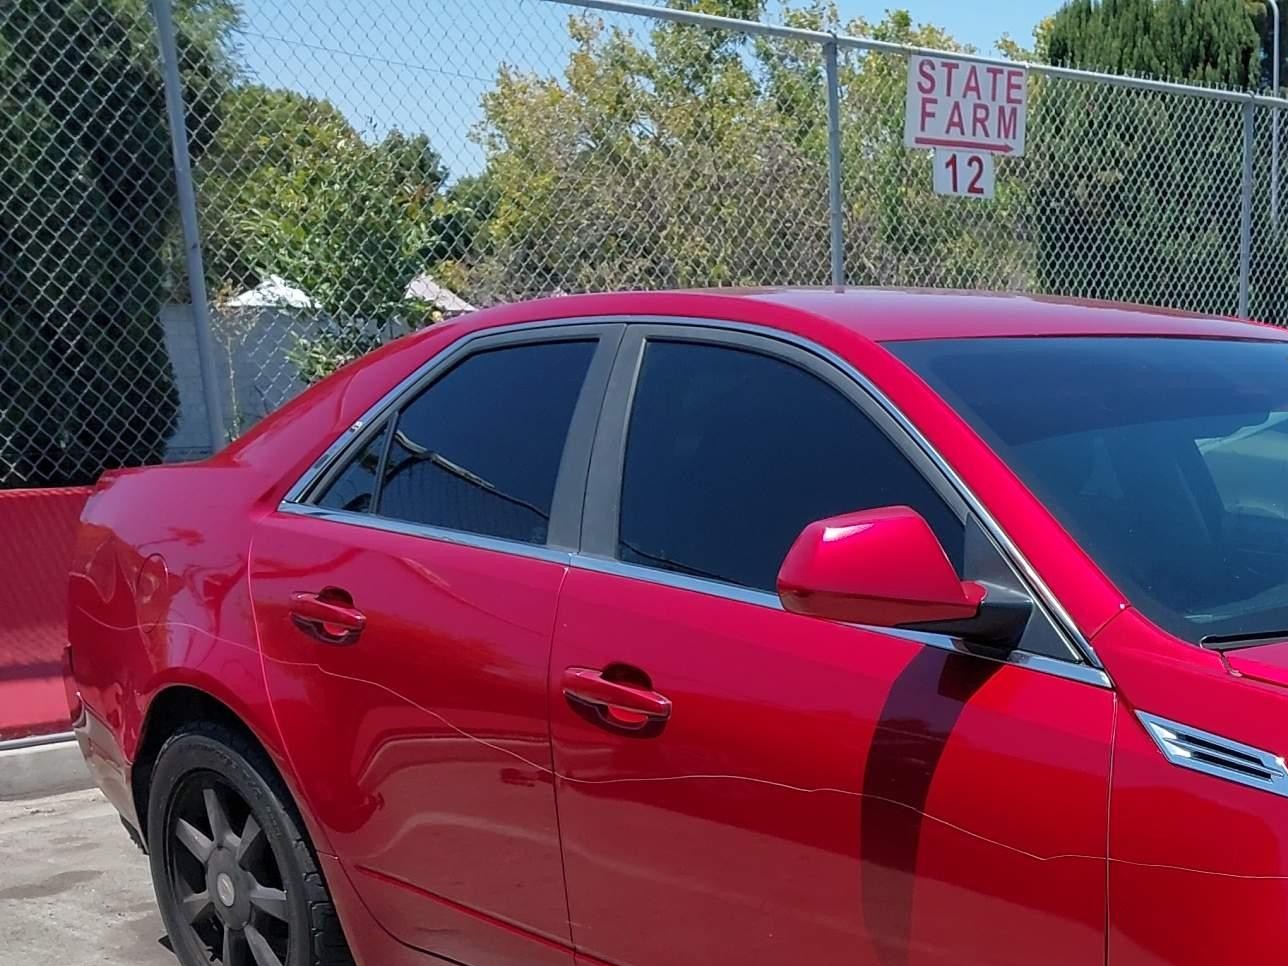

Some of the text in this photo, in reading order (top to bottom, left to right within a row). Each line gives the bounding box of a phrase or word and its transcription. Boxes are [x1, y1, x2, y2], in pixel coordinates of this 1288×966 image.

[917, 59, 1023, 105] STATE
[920, 97, 1017, 140] FARM
[945, 154, 984, 194] 12
